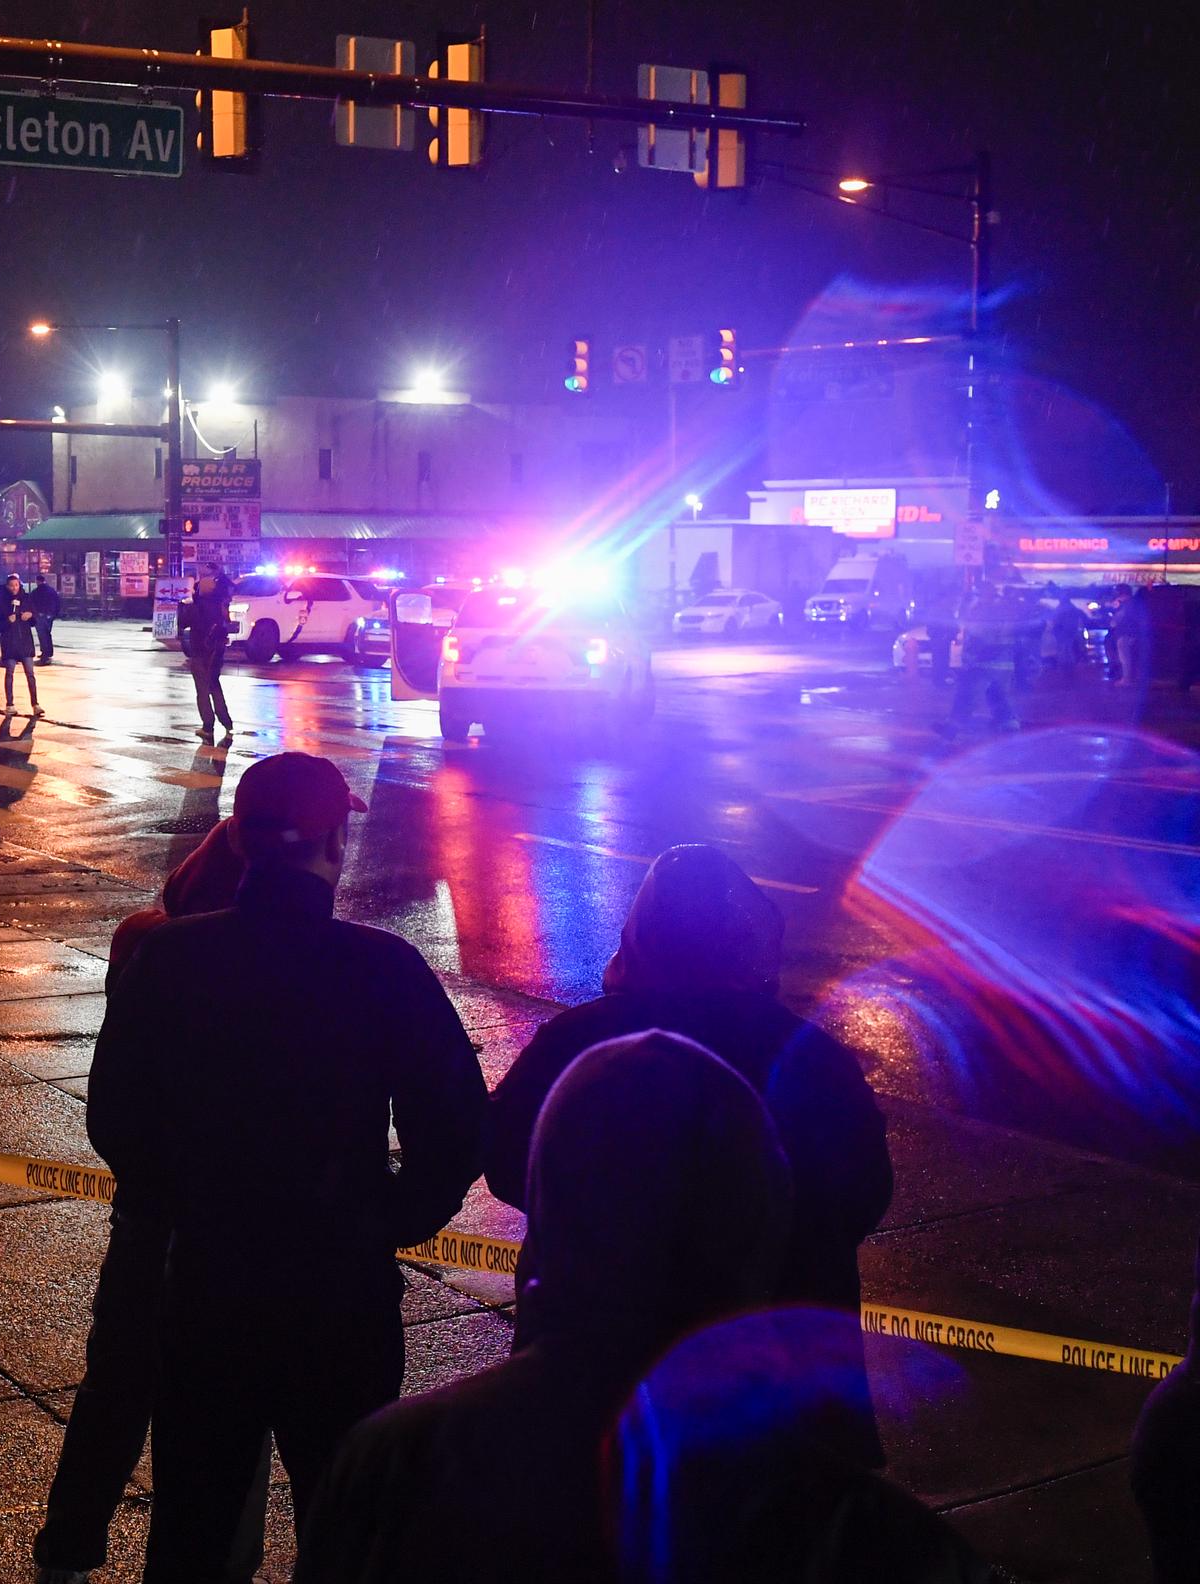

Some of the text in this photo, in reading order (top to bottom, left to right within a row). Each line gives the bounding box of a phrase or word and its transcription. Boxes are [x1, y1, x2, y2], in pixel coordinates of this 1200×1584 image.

[128, 119, 175, 163] Av
[181, 476, 256, 487] PRODUCE
[1019, 538, 1109, 551] ELECTRONICS
[26, 1163, 58, 1190] POLICE
[59, 1168, 81, 1195] LINE
[82, 1172, 96, 1198] DO
[441, 1236, 457, 1263] DO
[461, 1240, 483, 1268] NOT
[486, 1245, 520, 1274] CROS
[891, 1315, 910, 1338] DO
[915, 1319, 942, 1343] NOT
[947, 1325, 996, 1353] CROSS
[1062, 1344, 1115, 1370] POLICE
[1121, 1354, 1154, 1377] LINE
